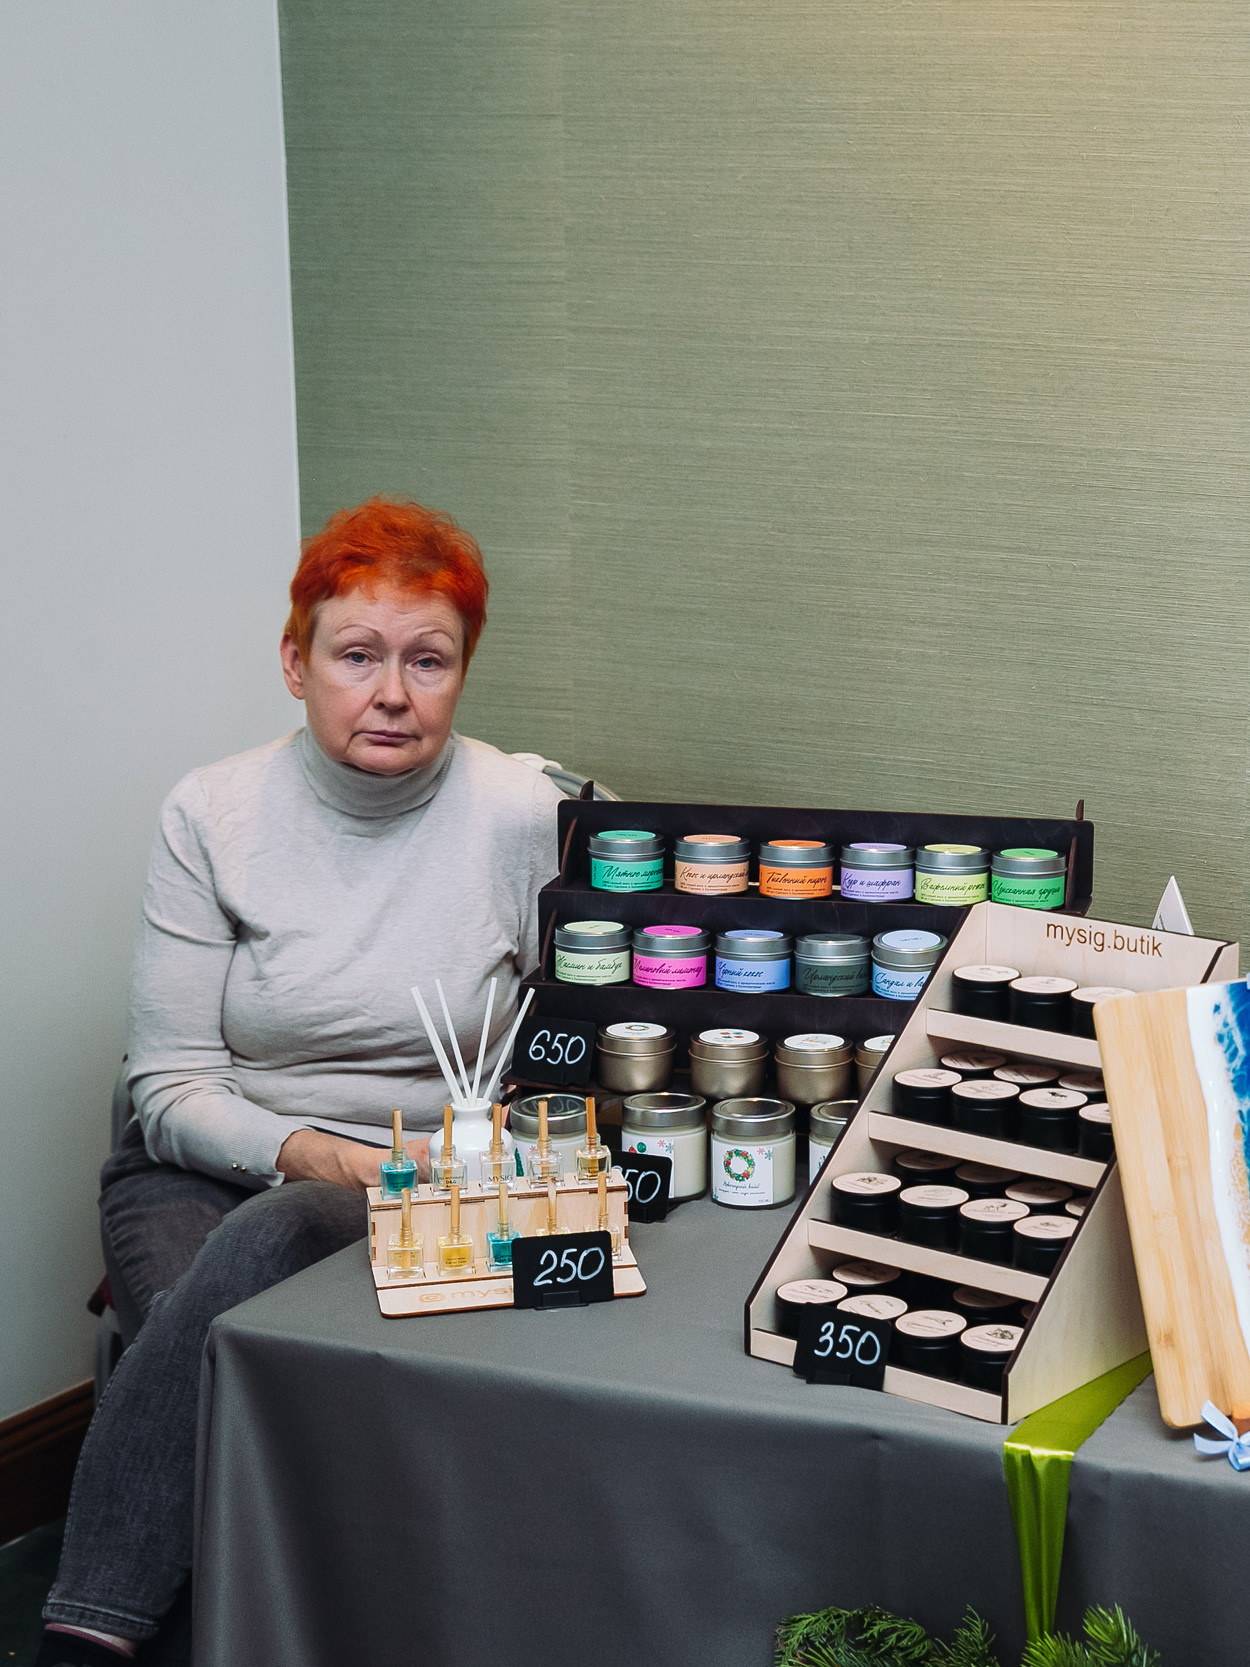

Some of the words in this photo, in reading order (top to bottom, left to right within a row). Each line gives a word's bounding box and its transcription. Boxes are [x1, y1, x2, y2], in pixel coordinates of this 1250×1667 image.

[1046, 923, 1163, 958] mysig.butik
[528, 1029, 586, 1065] 650
[611, 1165, 662, 1203] 50
[533, 1247, 605, 1286] 250
[813, 1321, 881, 1365] 350
